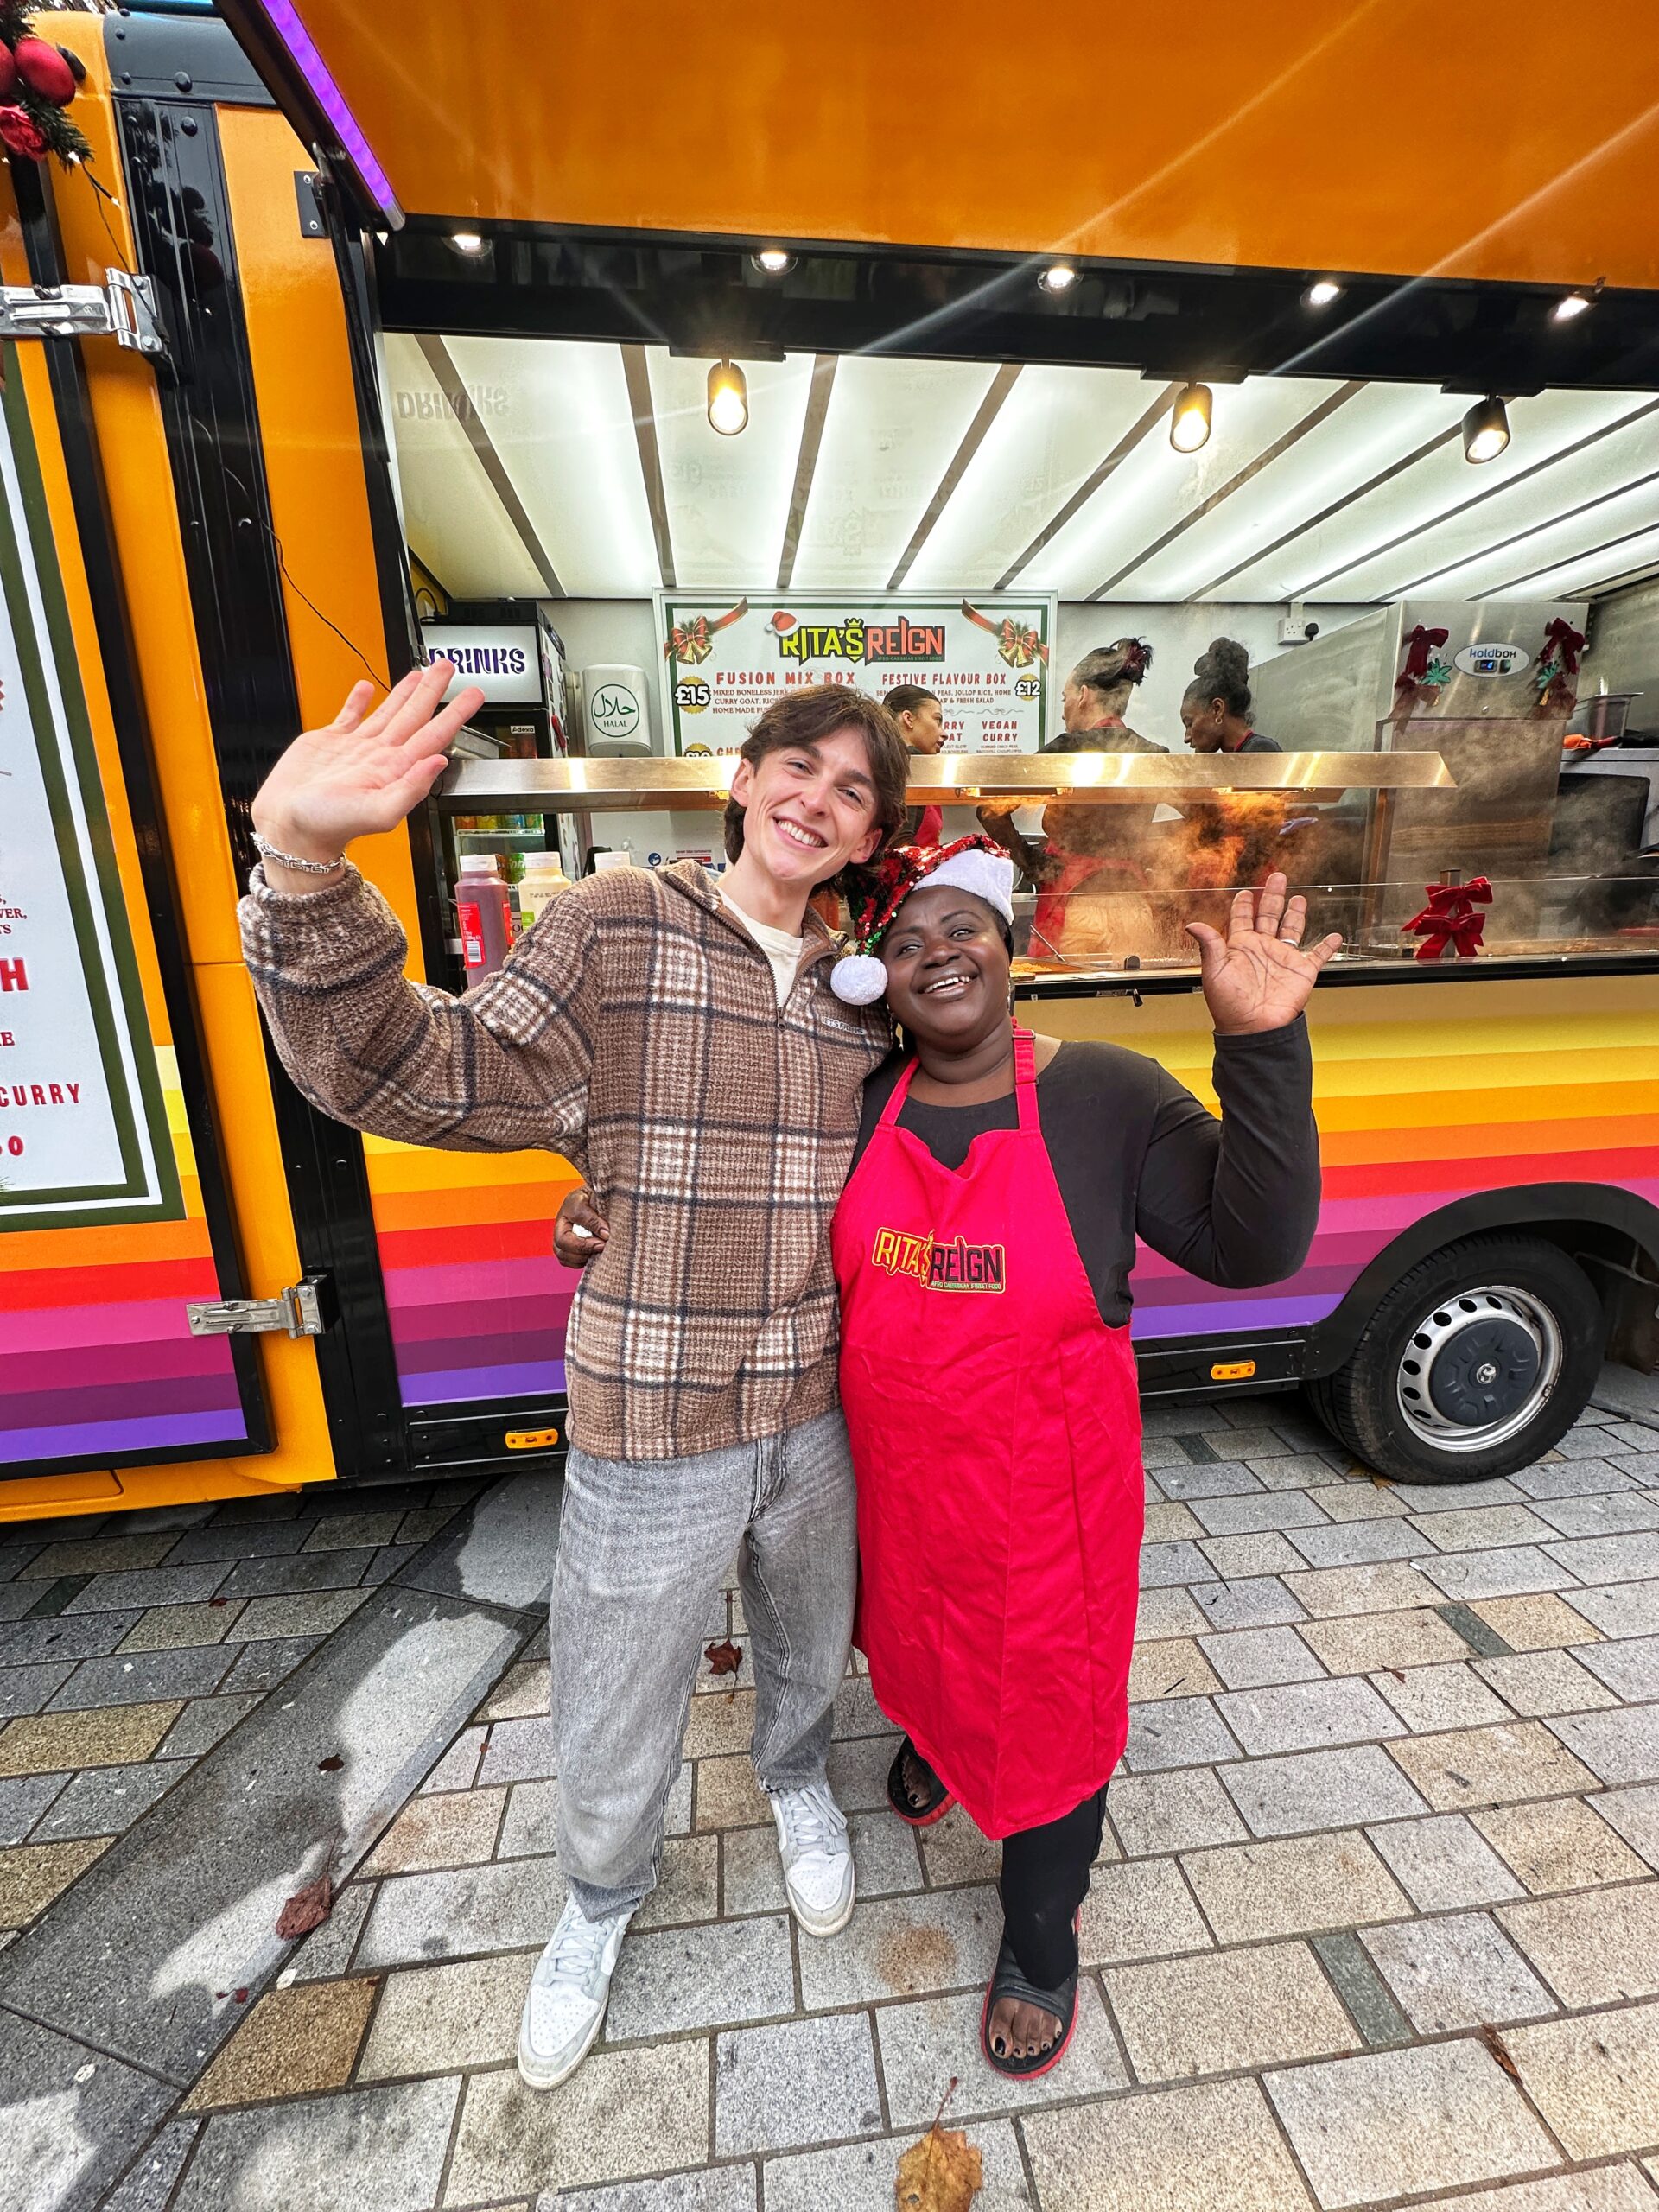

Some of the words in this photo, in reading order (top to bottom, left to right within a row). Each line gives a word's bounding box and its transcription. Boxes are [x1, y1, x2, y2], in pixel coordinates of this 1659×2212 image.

[867, 618, 943, 660] REIGN
[716, 672, 775, 685] FUSION
[785, 672, 814, 685] MIX
[824, 672, 855, 685] BOX
[882, 674, 927, 685] FESTIVE
[932, 674, 980, 685] FLAVOUR
[986, 673, 1007, 685] BOX
[674, 684, 710, 706] £15
[1014, 680, 1041, 696] £12
[594, 693, 636, 717] حلال
[944, 721, 965, 730] RRY
[982, 721, 1018, 730] VEGAN
[948, 733, 963, 741] AT
[982, 733, 1018, 741] CURRY
[0, 1084, 79, 1107] CURRY
[876, 1231, 931, 1277] RITA'S
[929, 1242, 1001, 1282] REIGN
